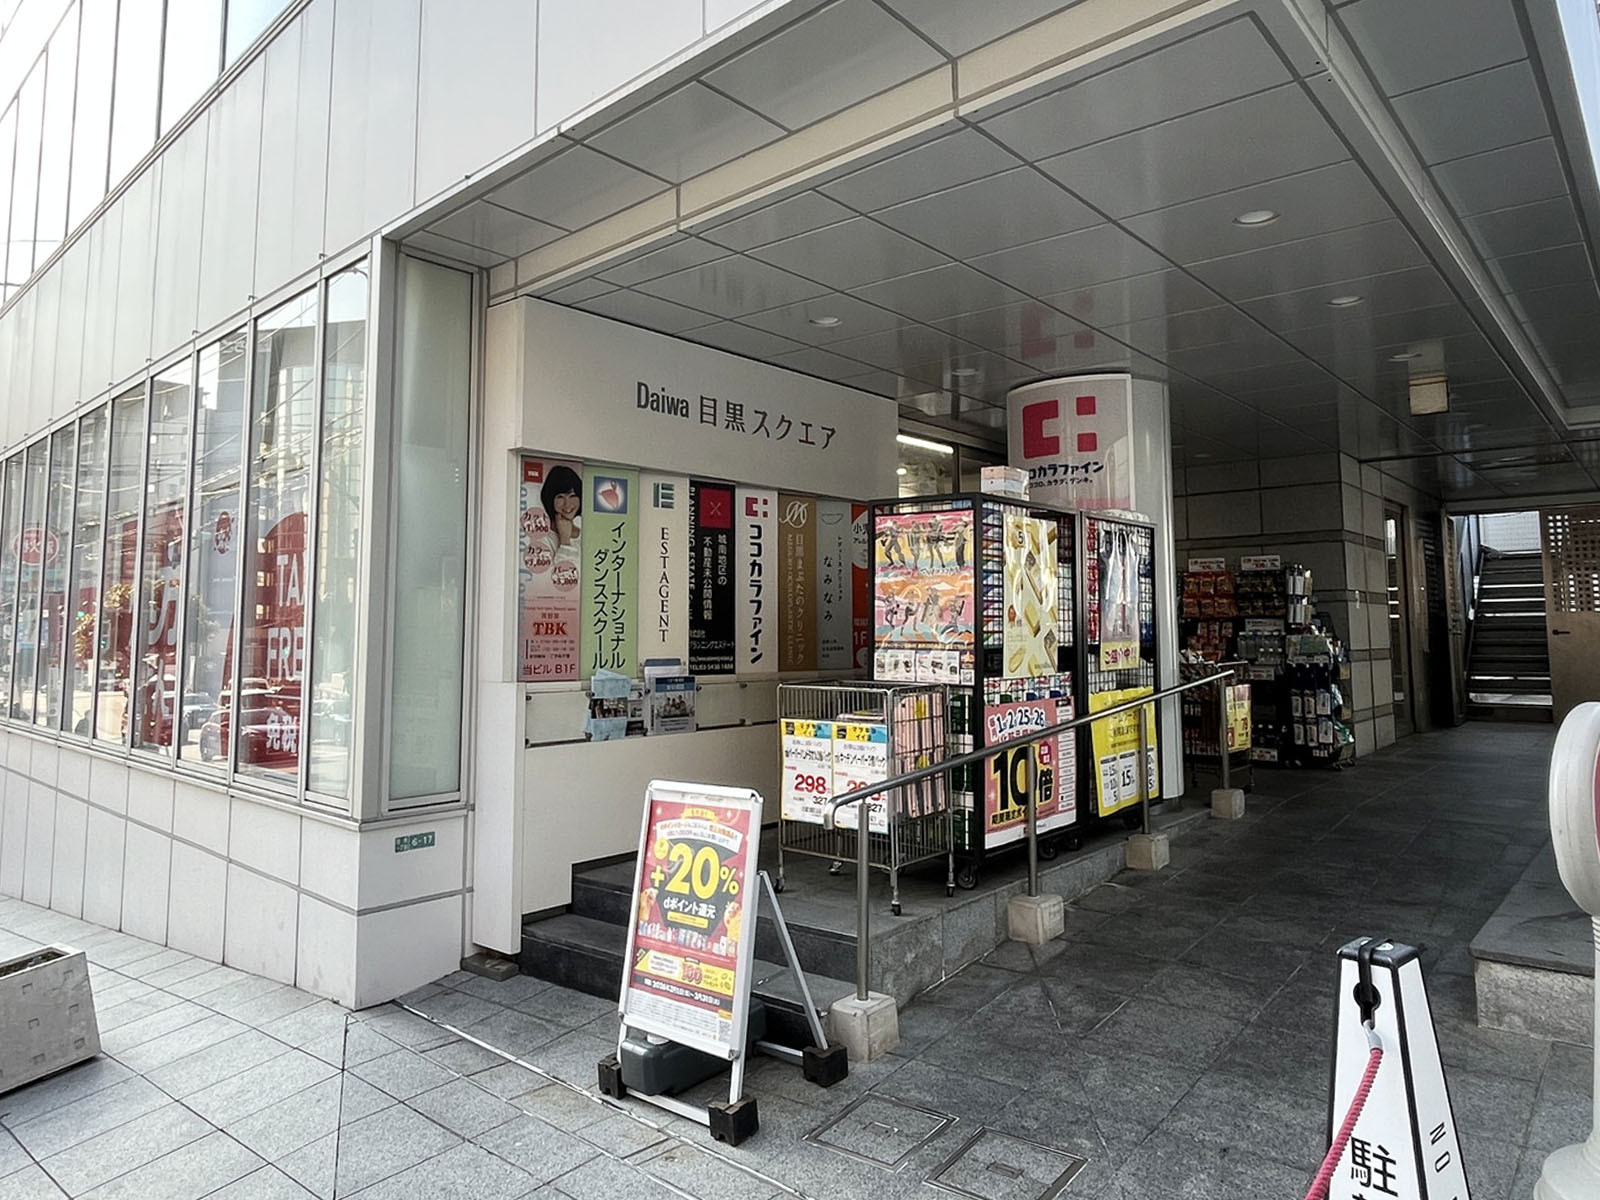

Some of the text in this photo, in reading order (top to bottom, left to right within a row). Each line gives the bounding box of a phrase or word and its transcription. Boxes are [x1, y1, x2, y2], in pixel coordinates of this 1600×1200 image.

[636, 381, 837, 450] Daiwa 目黒スクエア
[592, 549, 610, 671] ダンススクール
[610, 521, 627, 670] インターナショナル
[658, 526, 671, 642] ESTAGENT
[749, 524, 763, 665] ココカラファイン
[823, 556, 833, 622] なみなみ
[267, 627, 303, 682] FRE
[532, 622, 567, 636] TBK
[523, 663, 576, 676] 当ビル B1F
[793, 773, 828, 794] 298
[663, 896, 717, 919] dポイント還元
[1350, 1136, 1399, 1200] 駐
[1429, 1121, 1451, 1173] NO
